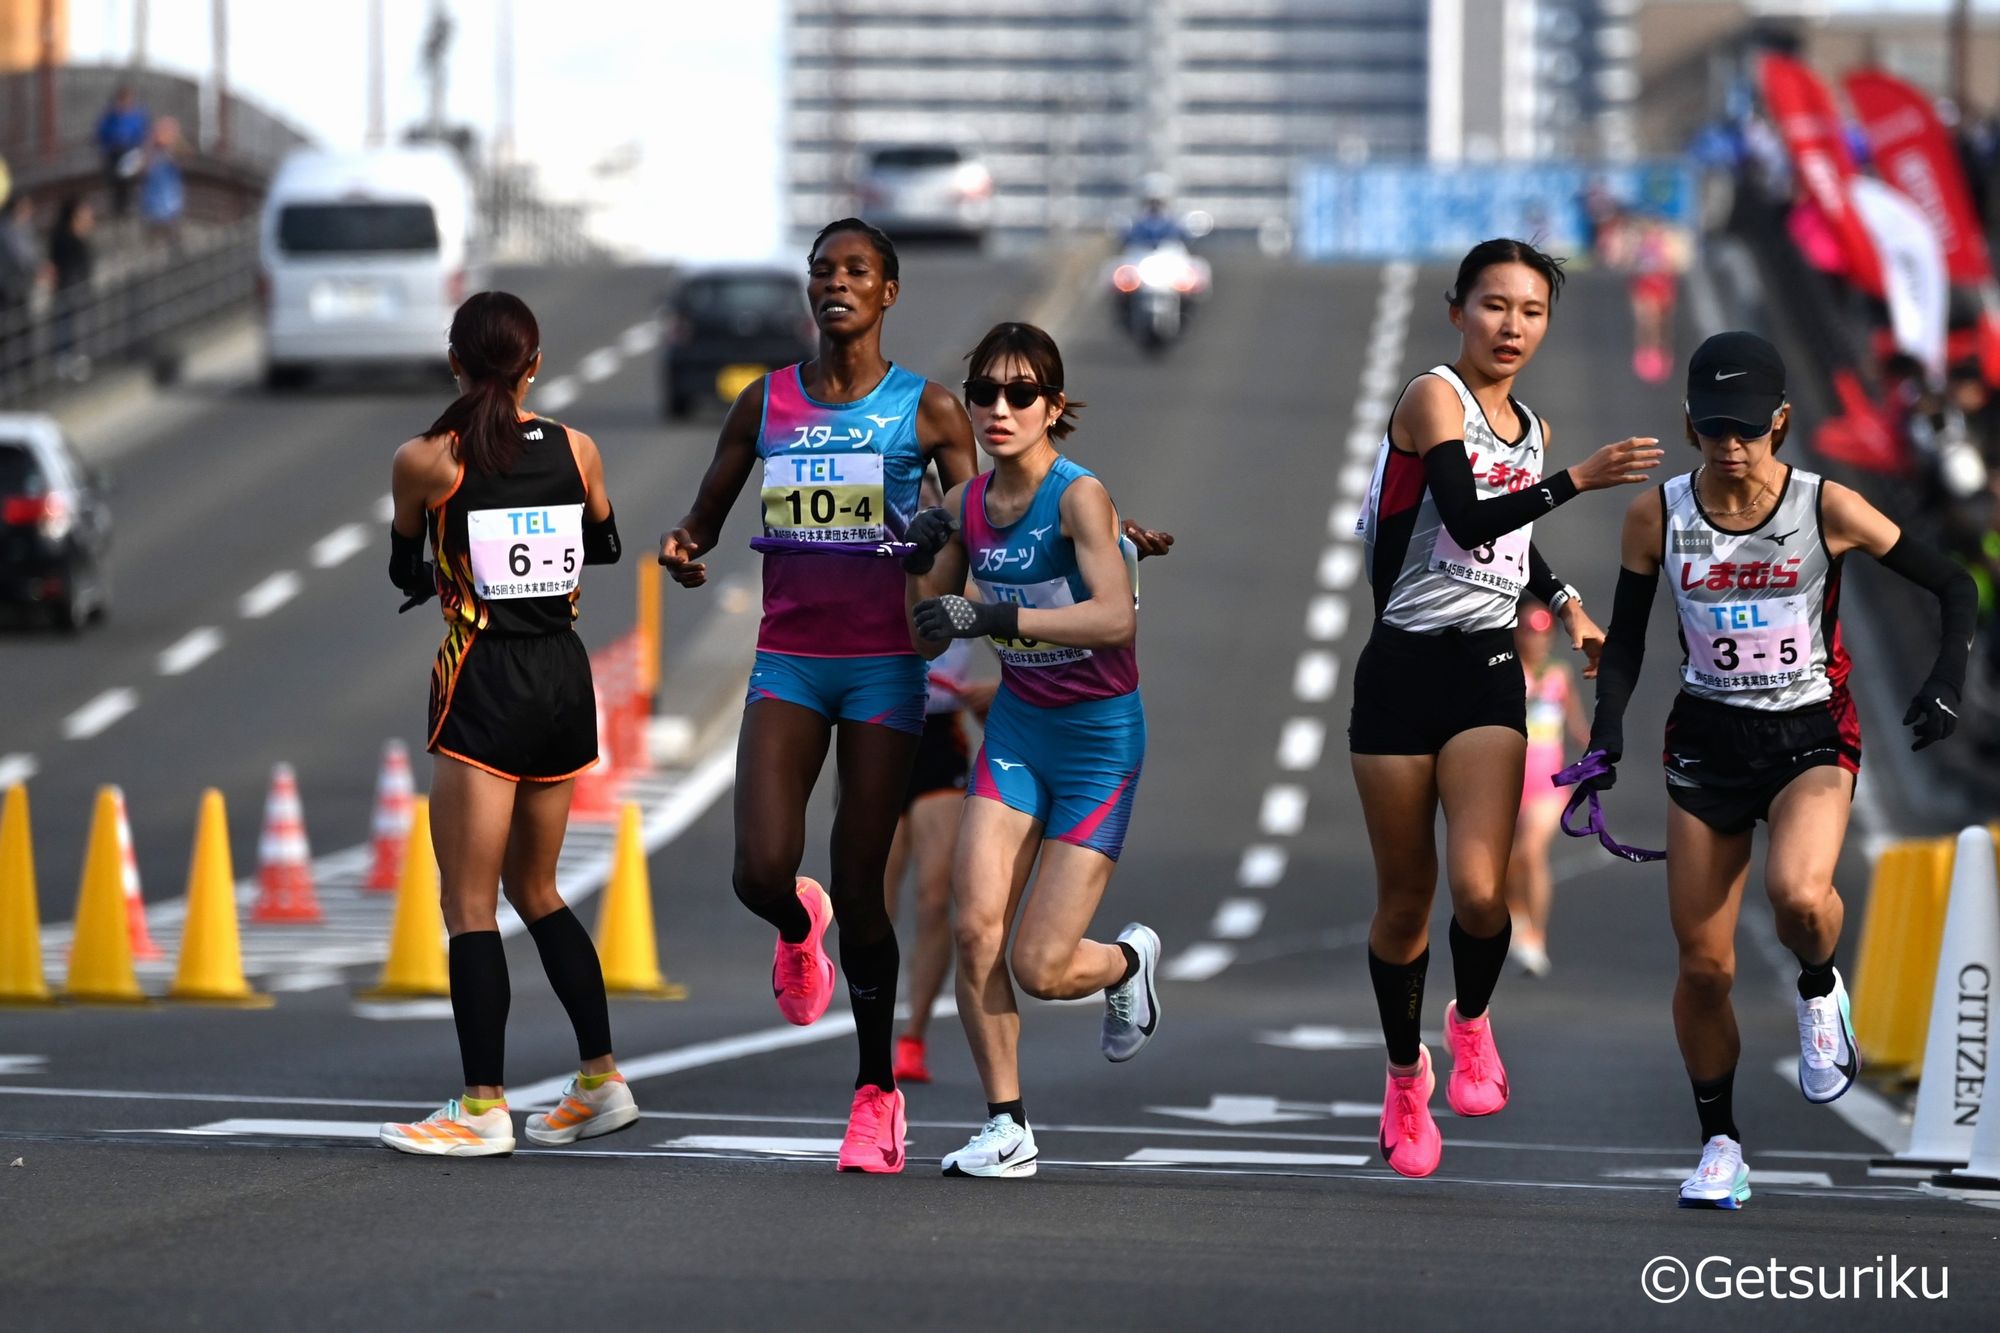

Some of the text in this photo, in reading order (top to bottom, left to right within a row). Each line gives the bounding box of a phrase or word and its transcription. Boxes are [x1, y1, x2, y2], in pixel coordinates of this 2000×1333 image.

[790, 426, 873, 448] スターツ
[791, 458, 844, 482] TEL
[507, 511, 556, 535] TEL
[977, 546, 1035, 572] スターツ
[1680, 558, 1801, 592] しまむら
[1709, 605, 1768, 629] TEL
[1488, 650, 1514, 667] 2XU
[1954, 963, 1991, 1126] CITIZEN
